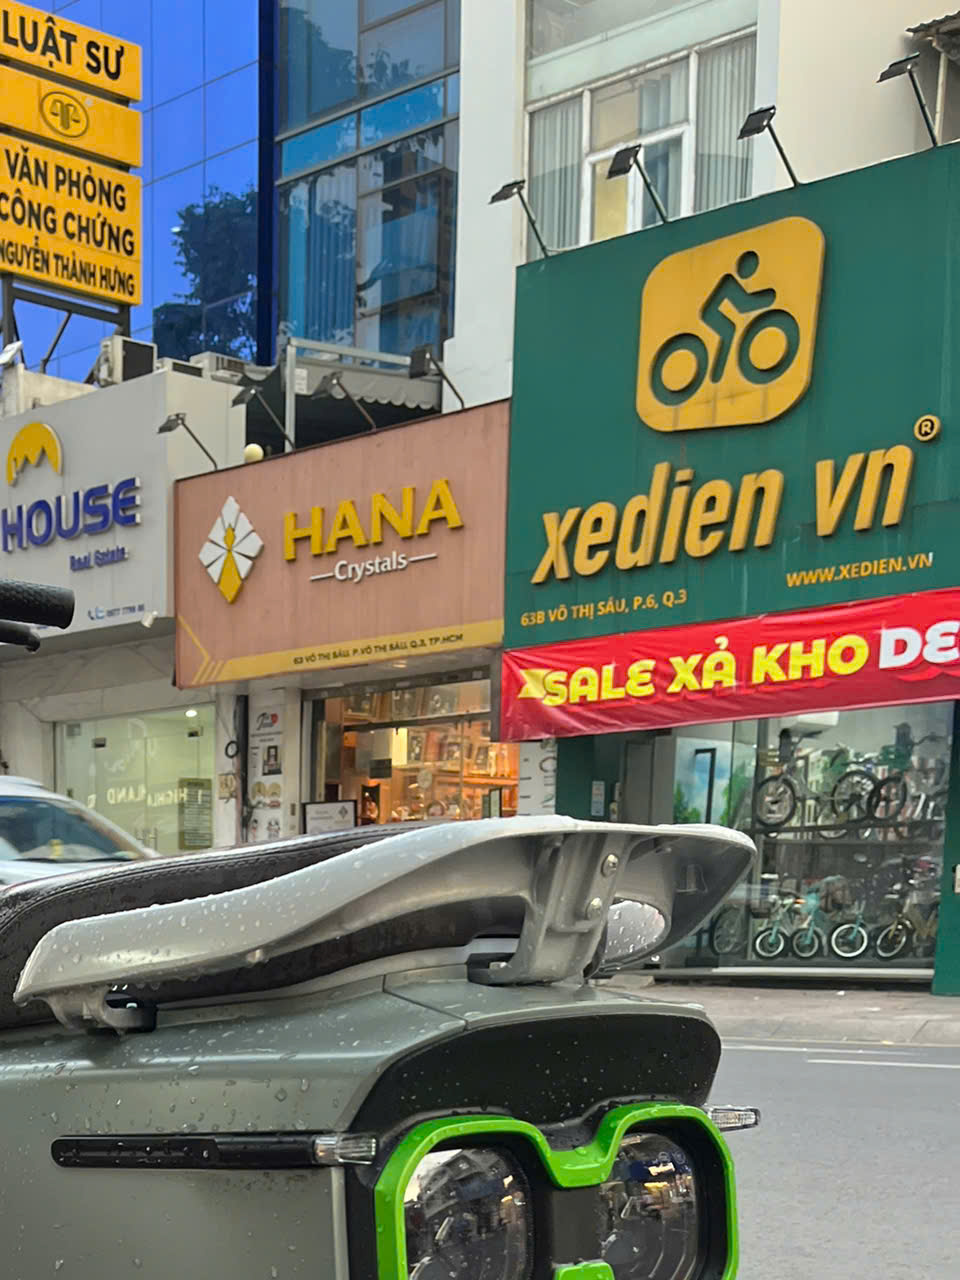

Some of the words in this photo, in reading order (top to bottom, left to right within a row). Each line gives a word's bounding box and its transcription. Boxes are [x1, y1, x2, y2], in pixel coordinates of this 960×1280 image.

[2, 9, 77, 68] LUẬT
[86, 40, 124, 80] SƯ
[5, 145, 48, 189] VĂN
[55, 165, 126, 211] PHÒNG
[63, 213, 135, 257] CHỨNG
[53, 252, 96, 287] THÀNH
[1, 476, 141, 554] HOUSE
[283, 477, 465, 563] HANA
[530, 461, 785, 585] xedien
[815, 444, 915, 538] vn
[786, 552, 934, 589] WWW.XEDIEN.VN
[520, 611, 545, 627] 63B
[548, 604, 569, 622] VÕ
[571, 604, 594, 620] THỊ
[597, 596, 629, 616] SÁU,
[662, 589, 688, 608] Q.3
[542, 658, 656, 707] SALE
[666, 636, 737, 694] XẢ
[751, 634, 869, 685] KHO
